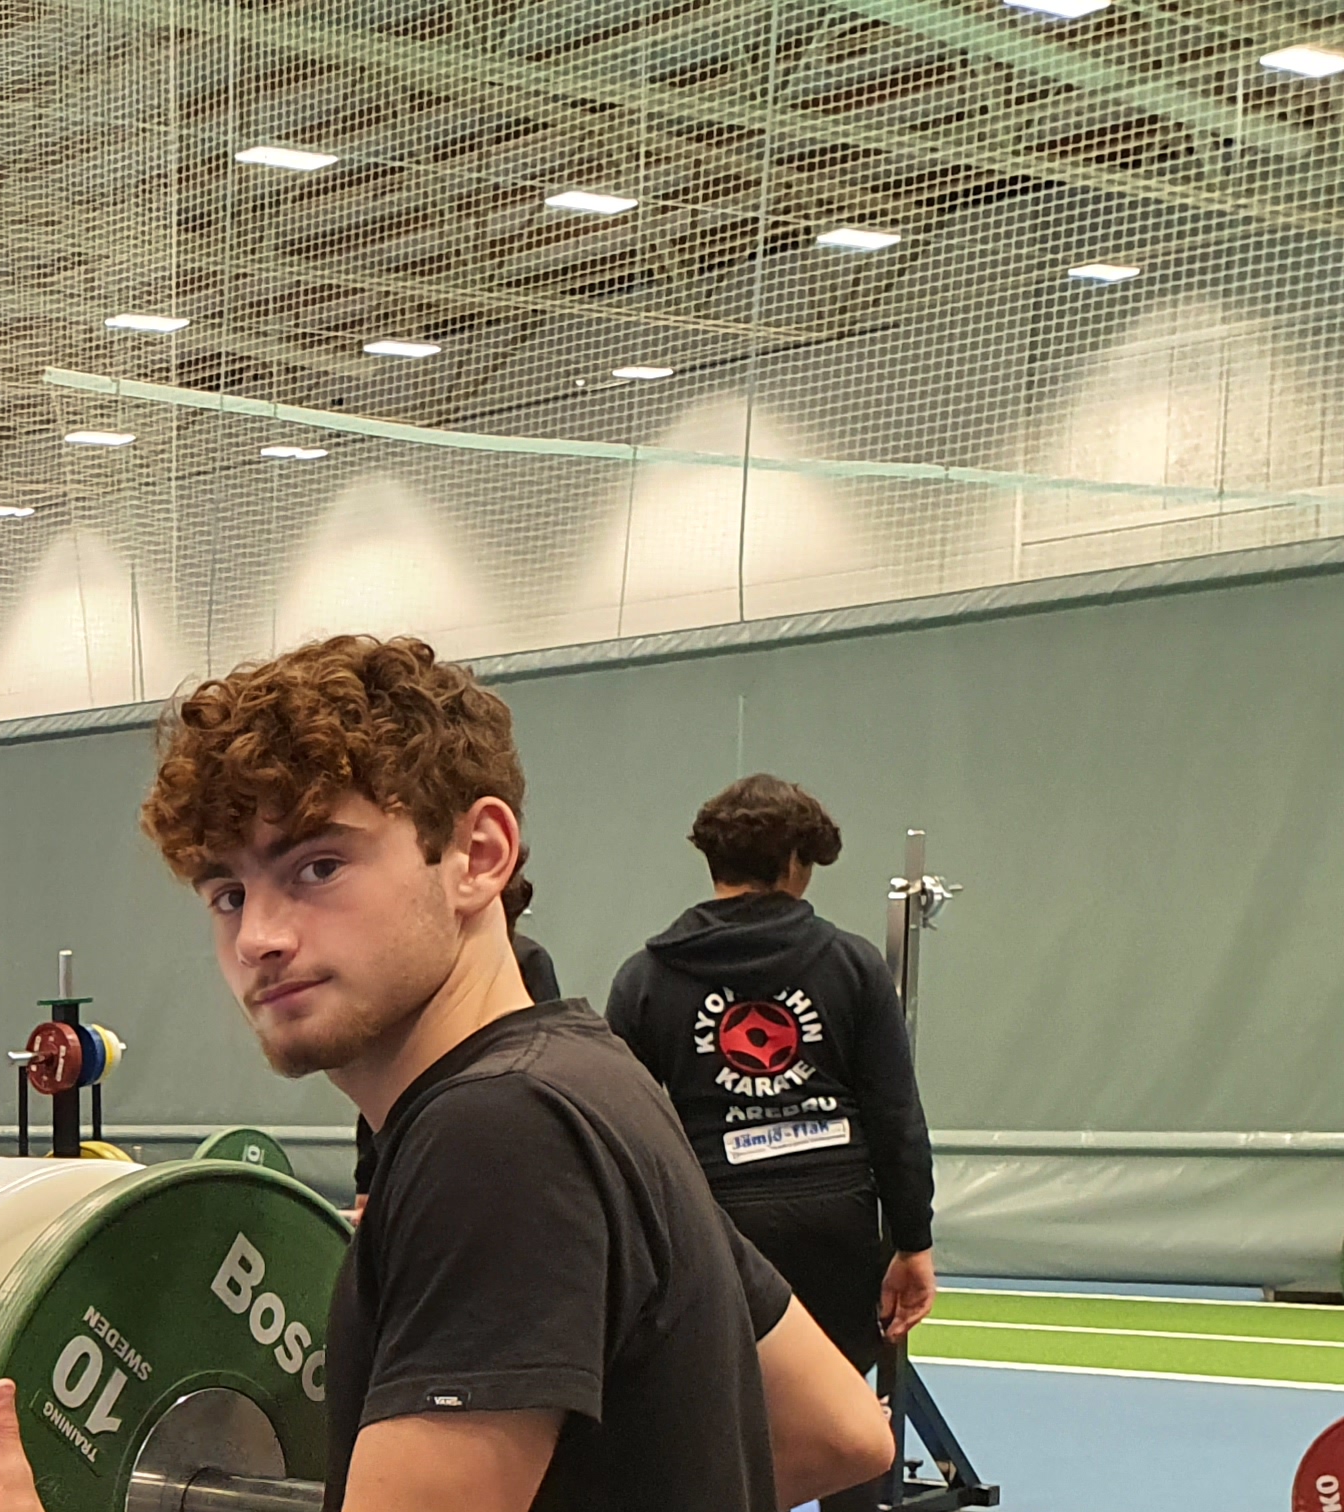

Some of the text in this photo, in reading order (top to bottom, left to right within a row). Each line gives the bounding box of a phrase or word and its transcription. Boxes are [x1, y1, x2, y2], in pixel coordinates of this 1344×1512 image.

[694, 986, 823, 1054] KYOHIN
[715, 1060, 816, 1097] KARATE
[82, 1305, 153, 1381] SWEDEN
[53, 1335, 128, 1435] 10
[43, 1401, 99, 1463] TRAINING
